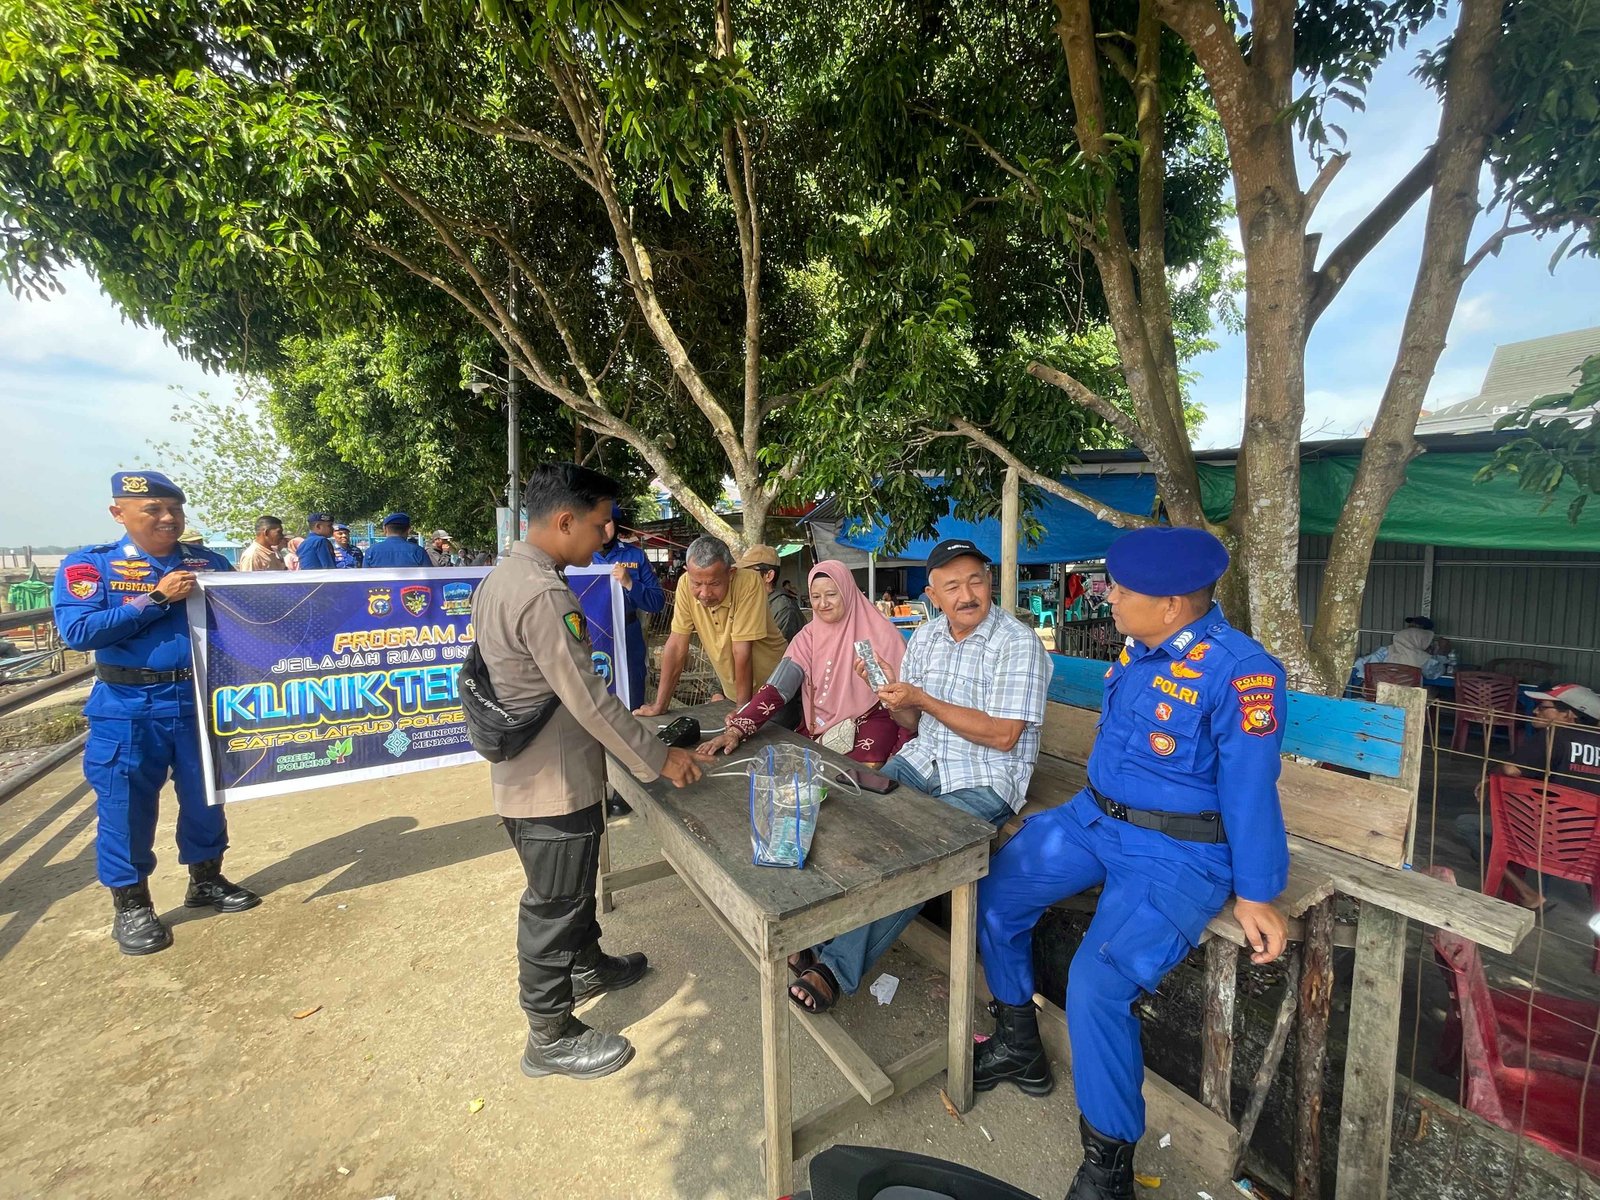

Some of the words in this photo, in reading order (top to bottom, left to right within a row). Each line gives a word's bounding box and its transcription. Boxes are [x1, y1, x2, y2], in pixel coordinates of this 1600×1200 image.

[333, 624, 456, 654] PROGRAM
[458, 623, 474, 643] J
[271, 651, 381, 674] JELAJAH
[386, 647, 436, 665] RIAU
[213, 672, 392, 735] KLINIK
[388, 663, 463, 714] TE
[1152, 676, 1199, 705] POLRI
[1243, 694, 1271, 702] RIAU
[226, 720, 394, 753] SATPOLAIRUD
[397, 711, 466, 730] POLRE
[276, 752, 316, 764] GREEN
[277, 758, 331, 772] POLICING
